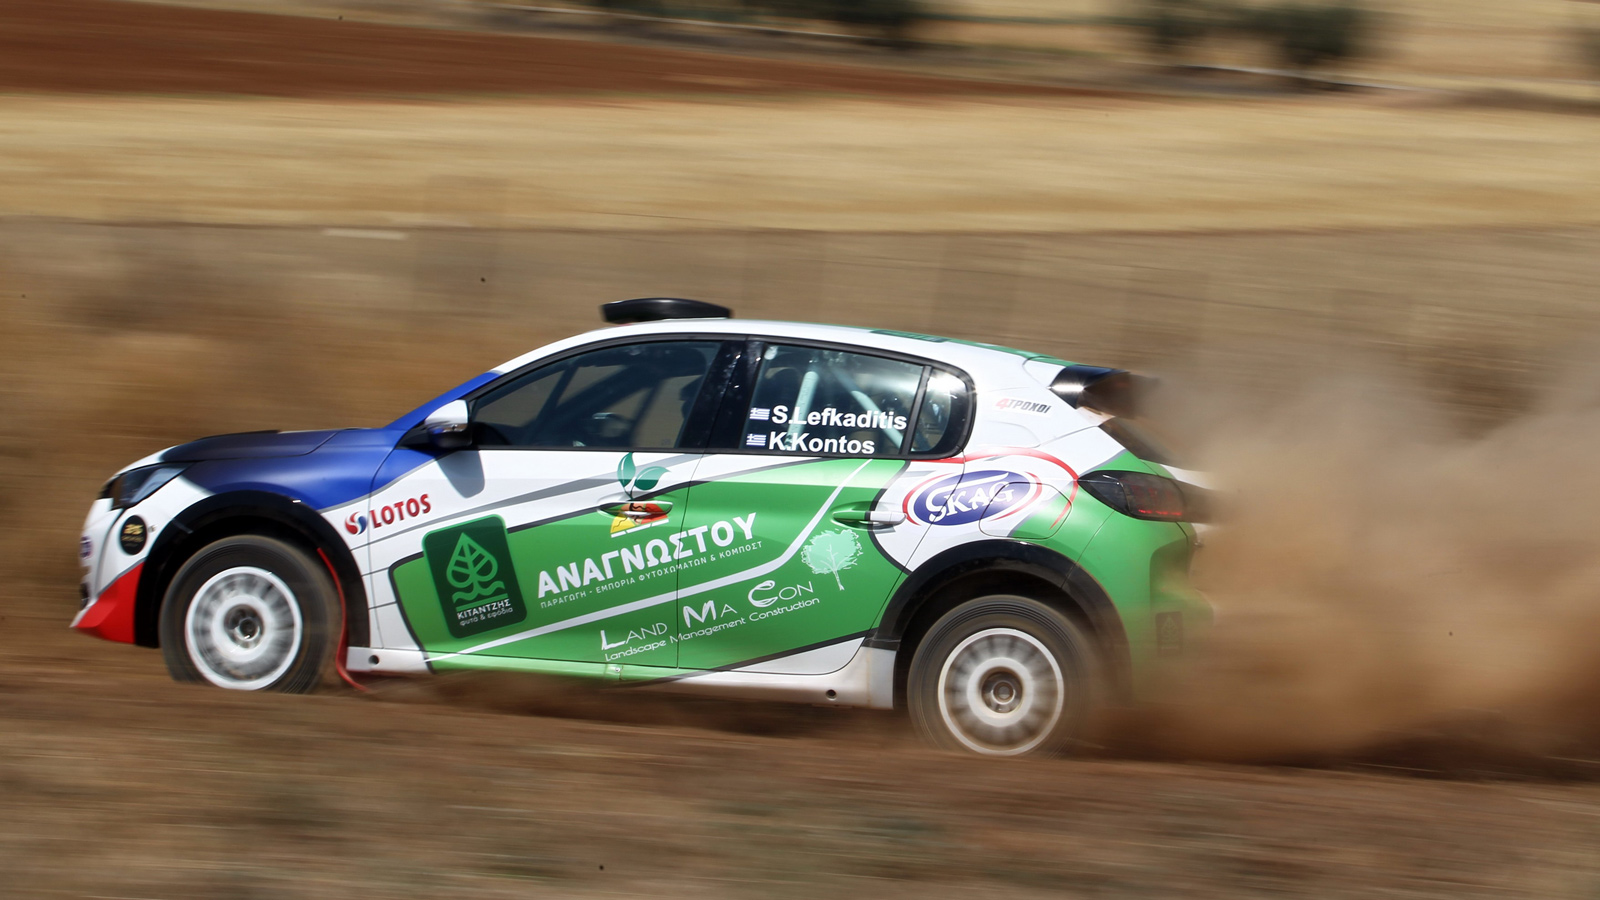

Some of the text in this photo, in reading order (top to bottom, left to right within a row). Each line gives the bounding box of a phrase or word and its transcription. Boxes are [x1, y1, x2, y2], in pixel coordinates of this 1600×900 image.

[771, 404, 908, 431] S.Lefkaditis
[768, 431, 876, 455] K.Kontos
[369, 493, 432, 529] LOTOS
[925, 471, 1015, 522] SKAG
[537, 512, 757, 599] ΑΝΑΓΝΩΣΤΟΥ
[540, 590, 587, 609] ΠΑΡΑΓΩΓΗ
[596, 578, 636, 594] ΕΜΠΟΡΙΑ
[638, 556, 708, 582] ΦΥΤΟΧΩΜΑΤΩΝ
[719, 540, 763, 559] ΚΟΜΠΟΣΤ
[457, 598, 511, 620] ΚΙΤΑΝΤΖΗΣ
[605, 597, 821, 662] Landscape Management Construction
